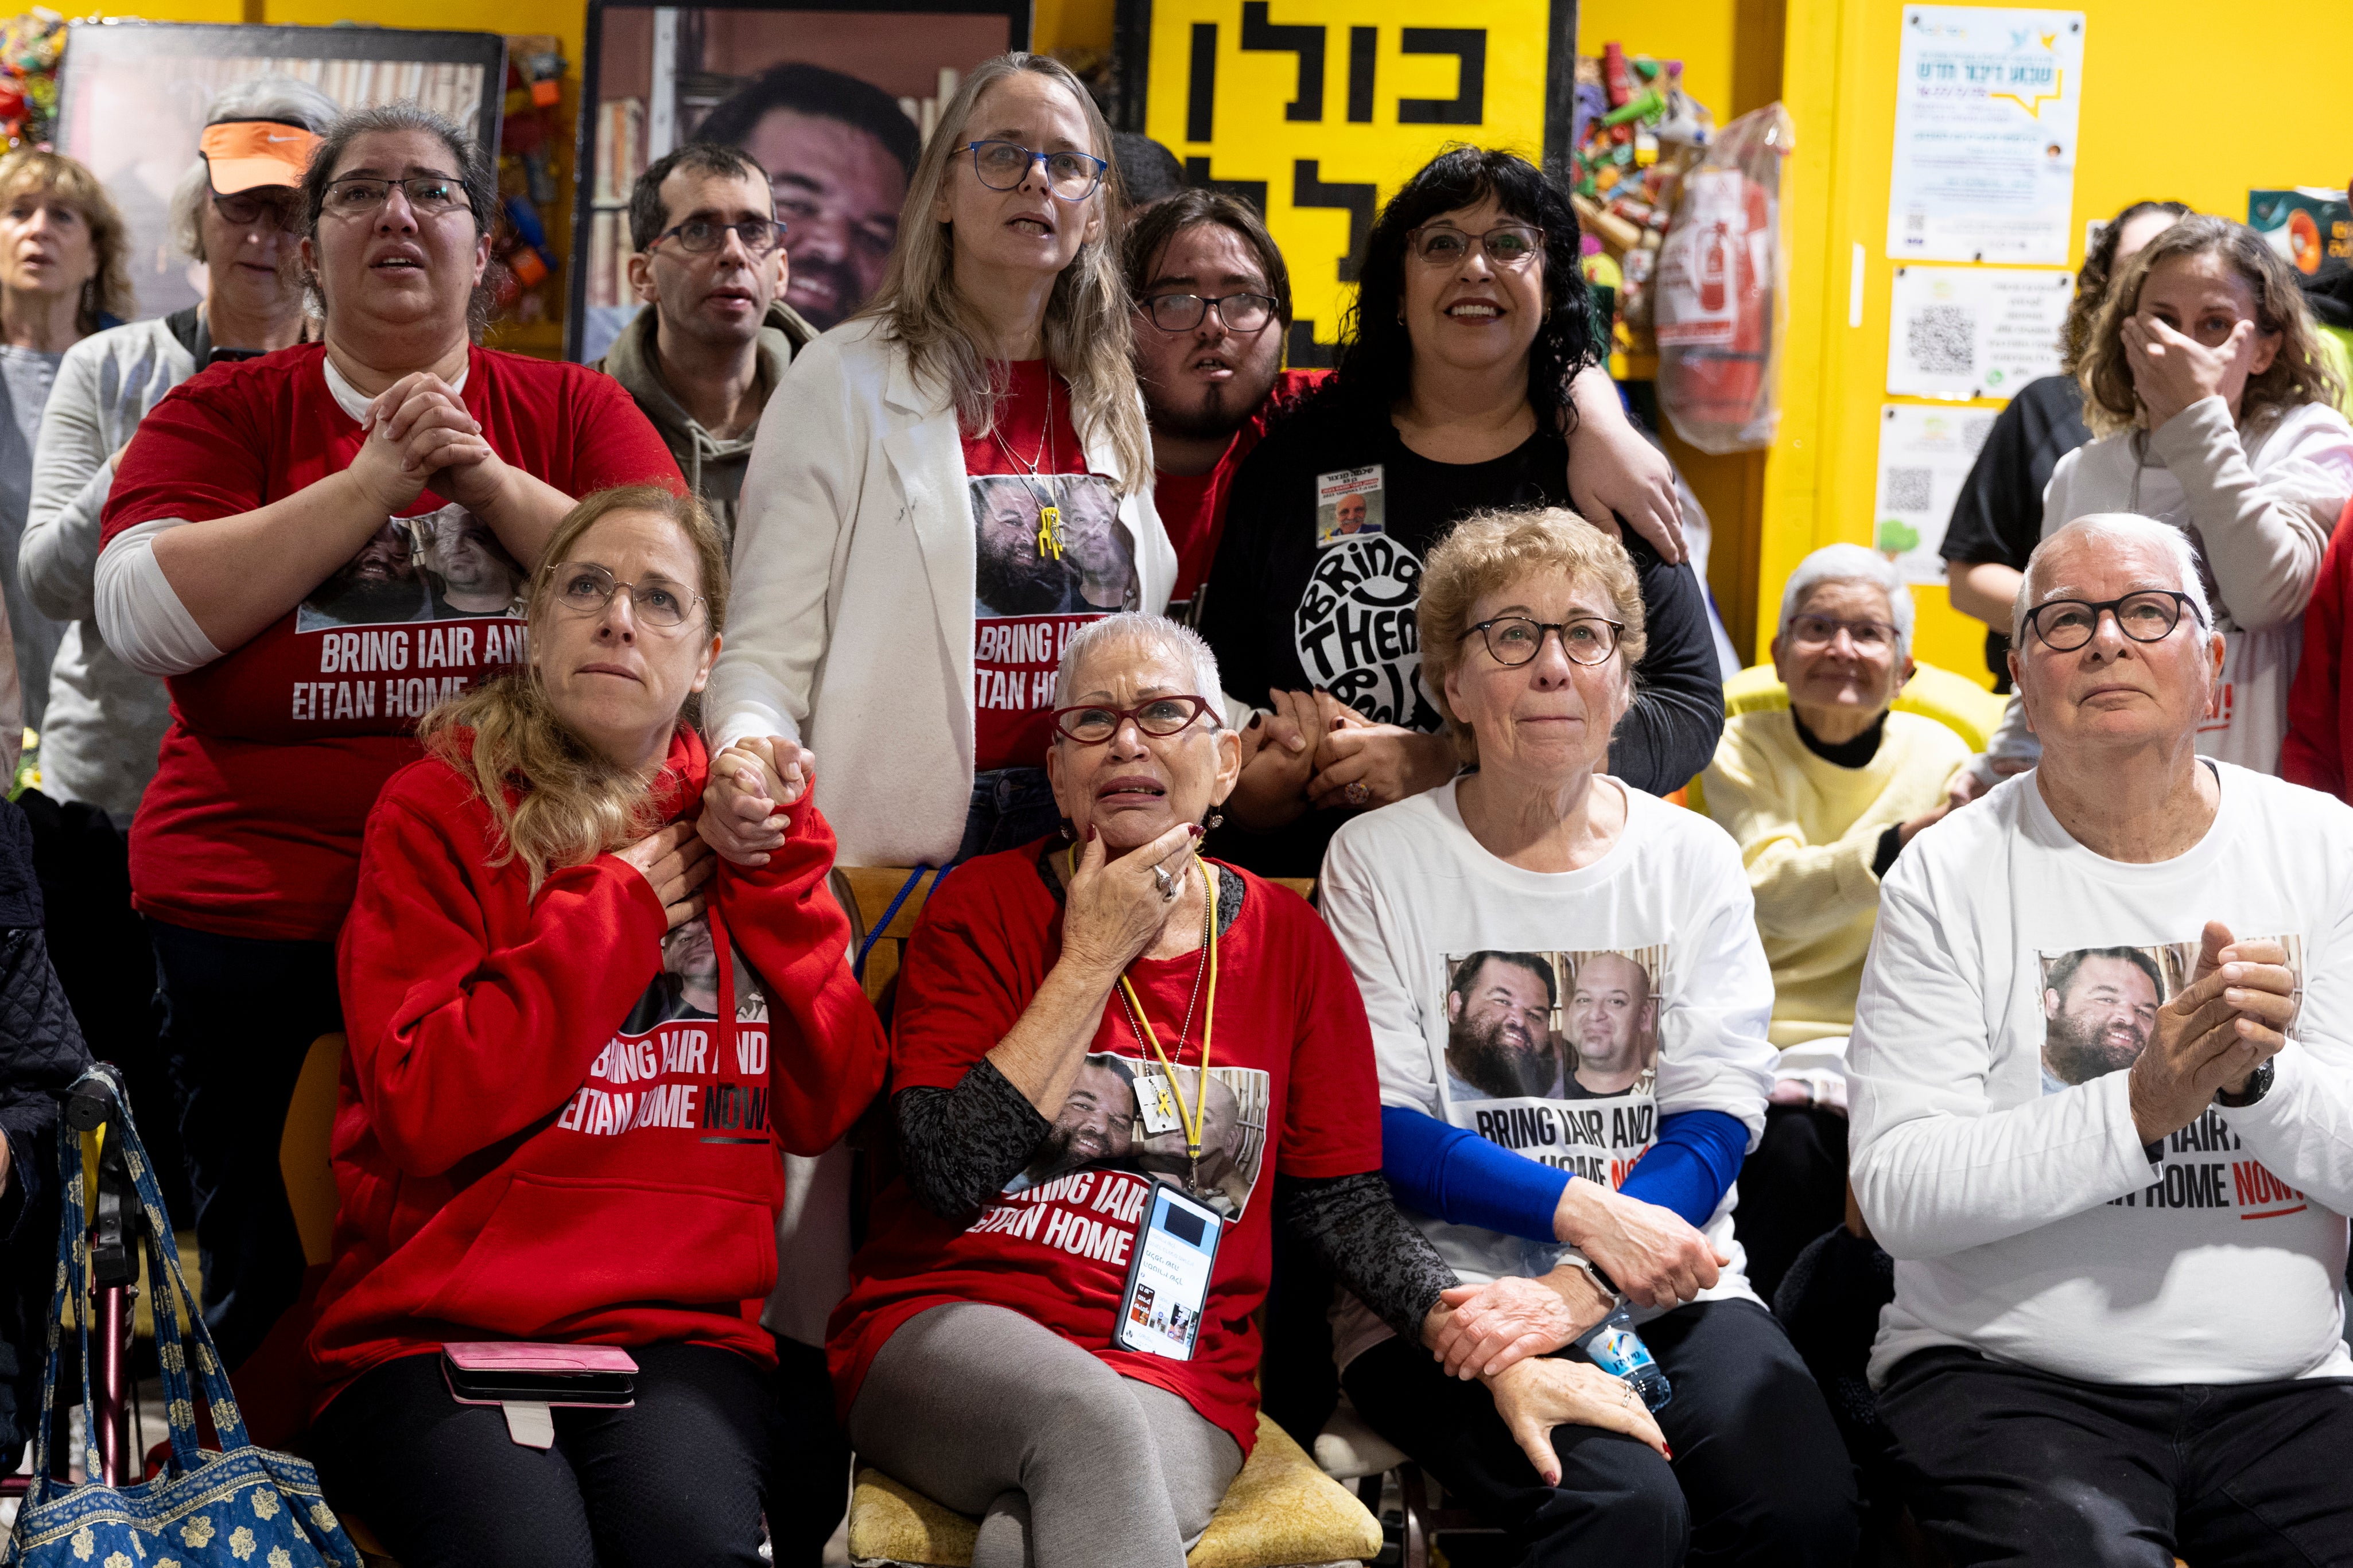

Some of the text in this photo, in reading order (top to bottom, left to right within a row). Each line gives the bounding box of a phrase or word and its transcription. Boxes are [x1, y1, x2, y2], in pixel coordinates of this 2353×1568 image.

[1186, 1, 1487, 142] כולן
[320, 631, 409, 673] BRING
[418, 627, 476, 668] IAIR
[975, 622, 1053, 664] BRING
[292, 676, 469, 721] EITAN HOME
[976, 668, 1027, 710] TAN
[590, 1029, 768, 1084] BRING IAIR ND
[557, 1084, 771, 1136] EITAN HOME NOW!
[1476, 1104, 1653, 1149] BRING IAIR AND
[2146, 1163, 2230, 1208] HOME
[965, 1202, 1135, 1266] EITAN HOME
[1143, 1261, 1182, 1286] הסטוריז שלך
[1146, 1250, 1179, 1271] מלפני שנה
